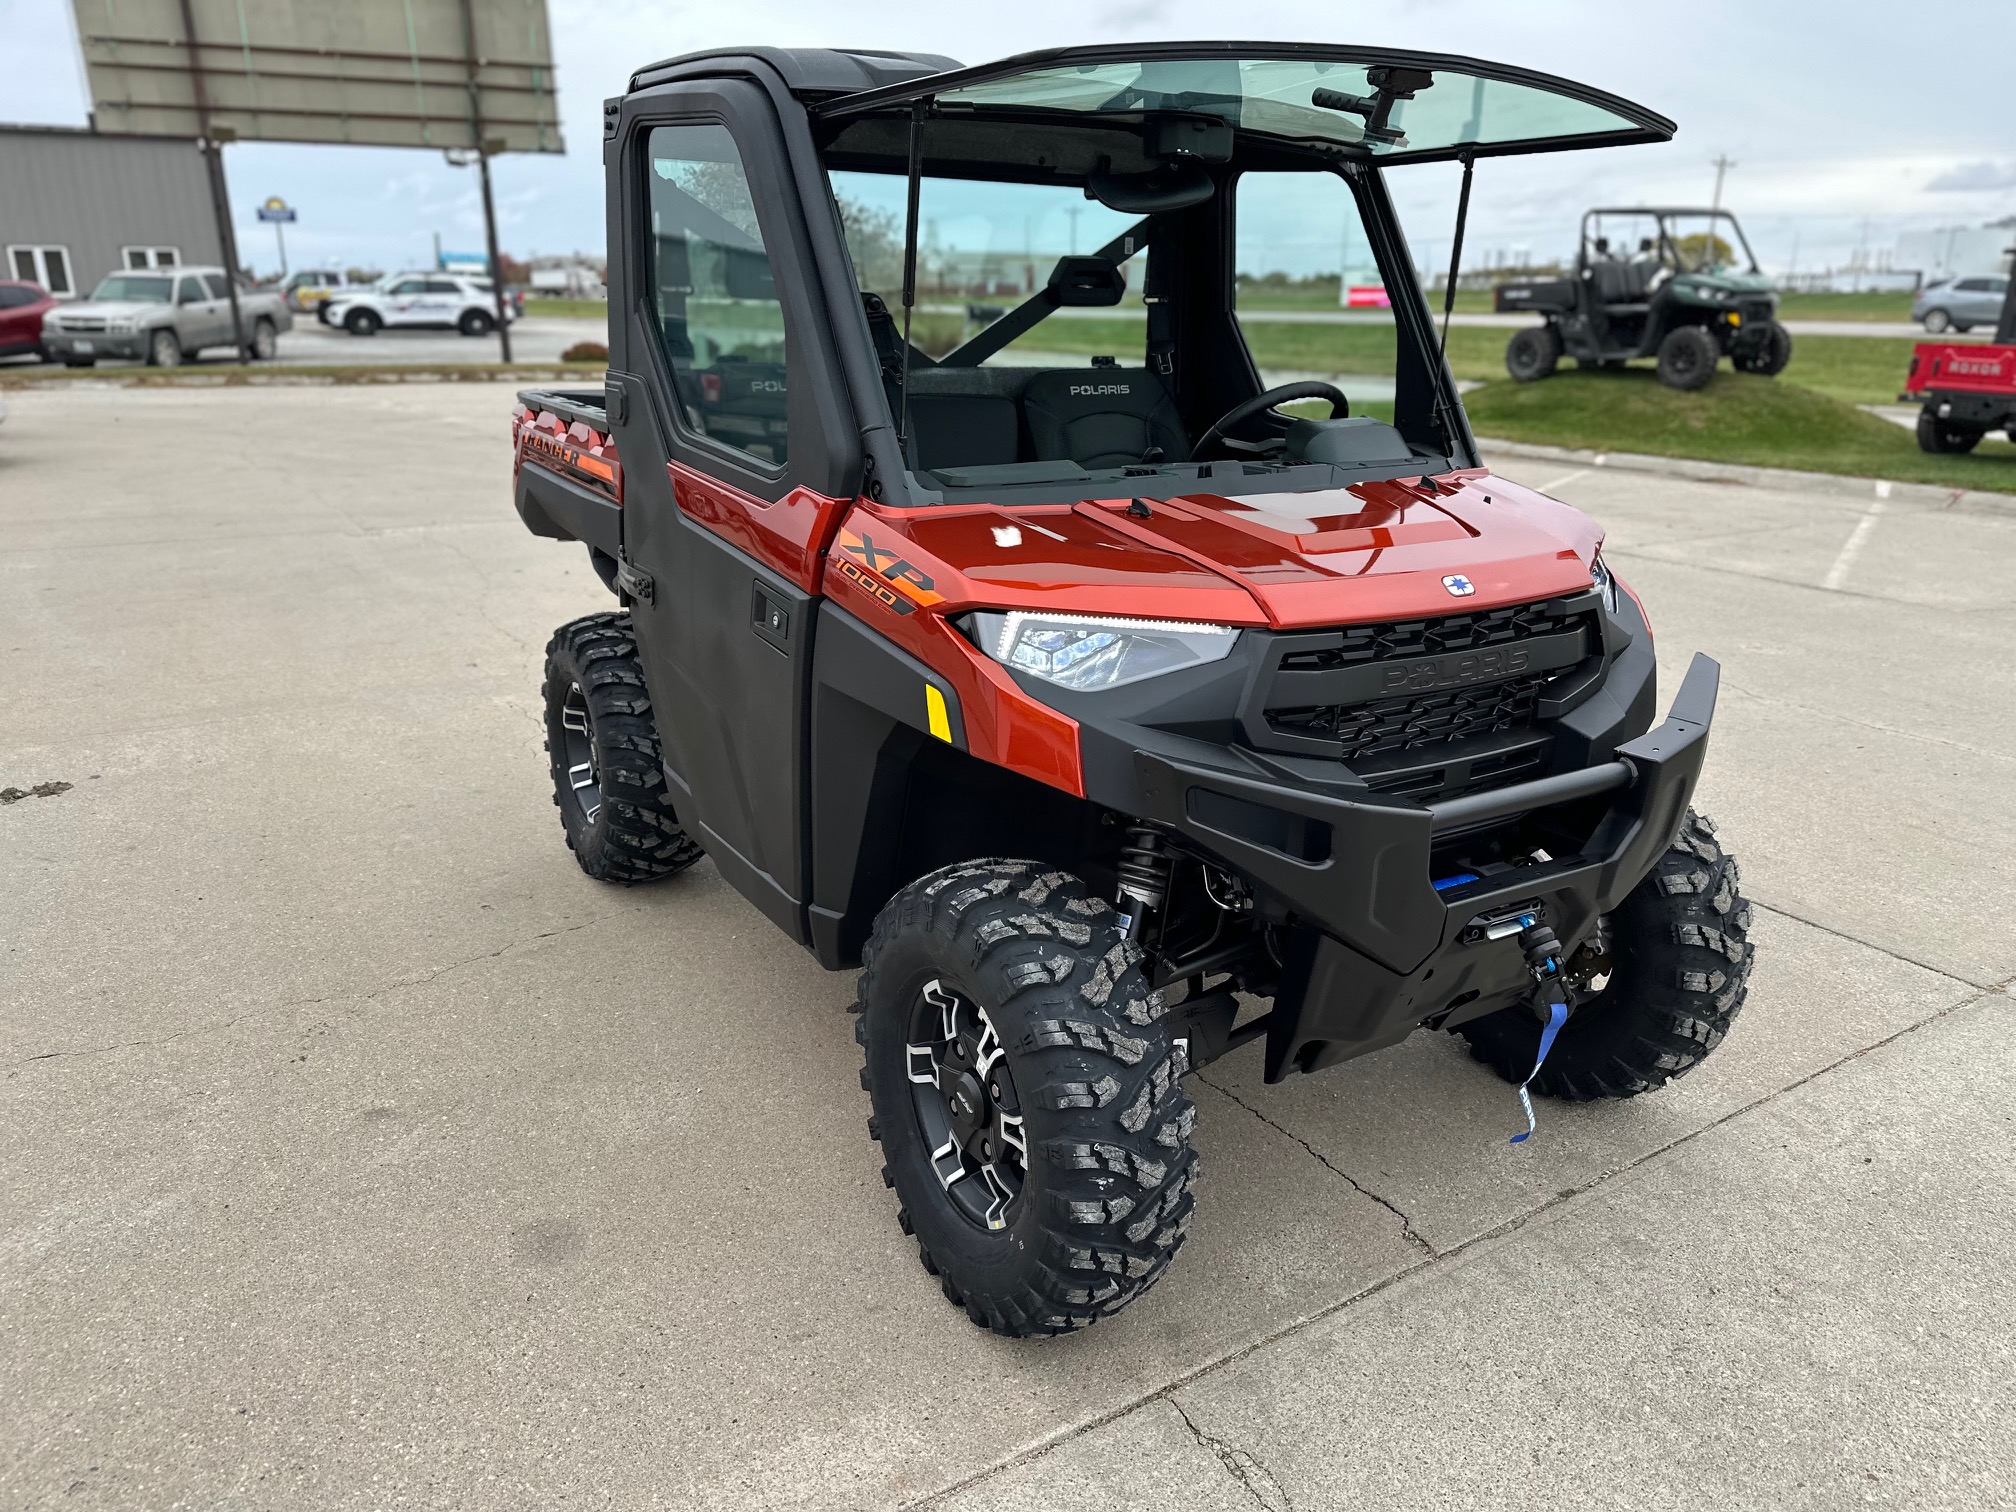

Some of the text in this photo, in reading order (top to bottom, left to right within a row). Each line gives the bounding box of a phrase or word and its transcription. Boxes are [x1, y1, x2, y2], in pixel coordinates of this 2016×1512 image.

[1069, 384, 1130, 396] POLARIS
[525, 433, 580, 465] RANGER
[835, 557, 897, 606] 1000
[841, 531, 935, 591] XP
[1380, 645, 1529, 694] POLARIS
